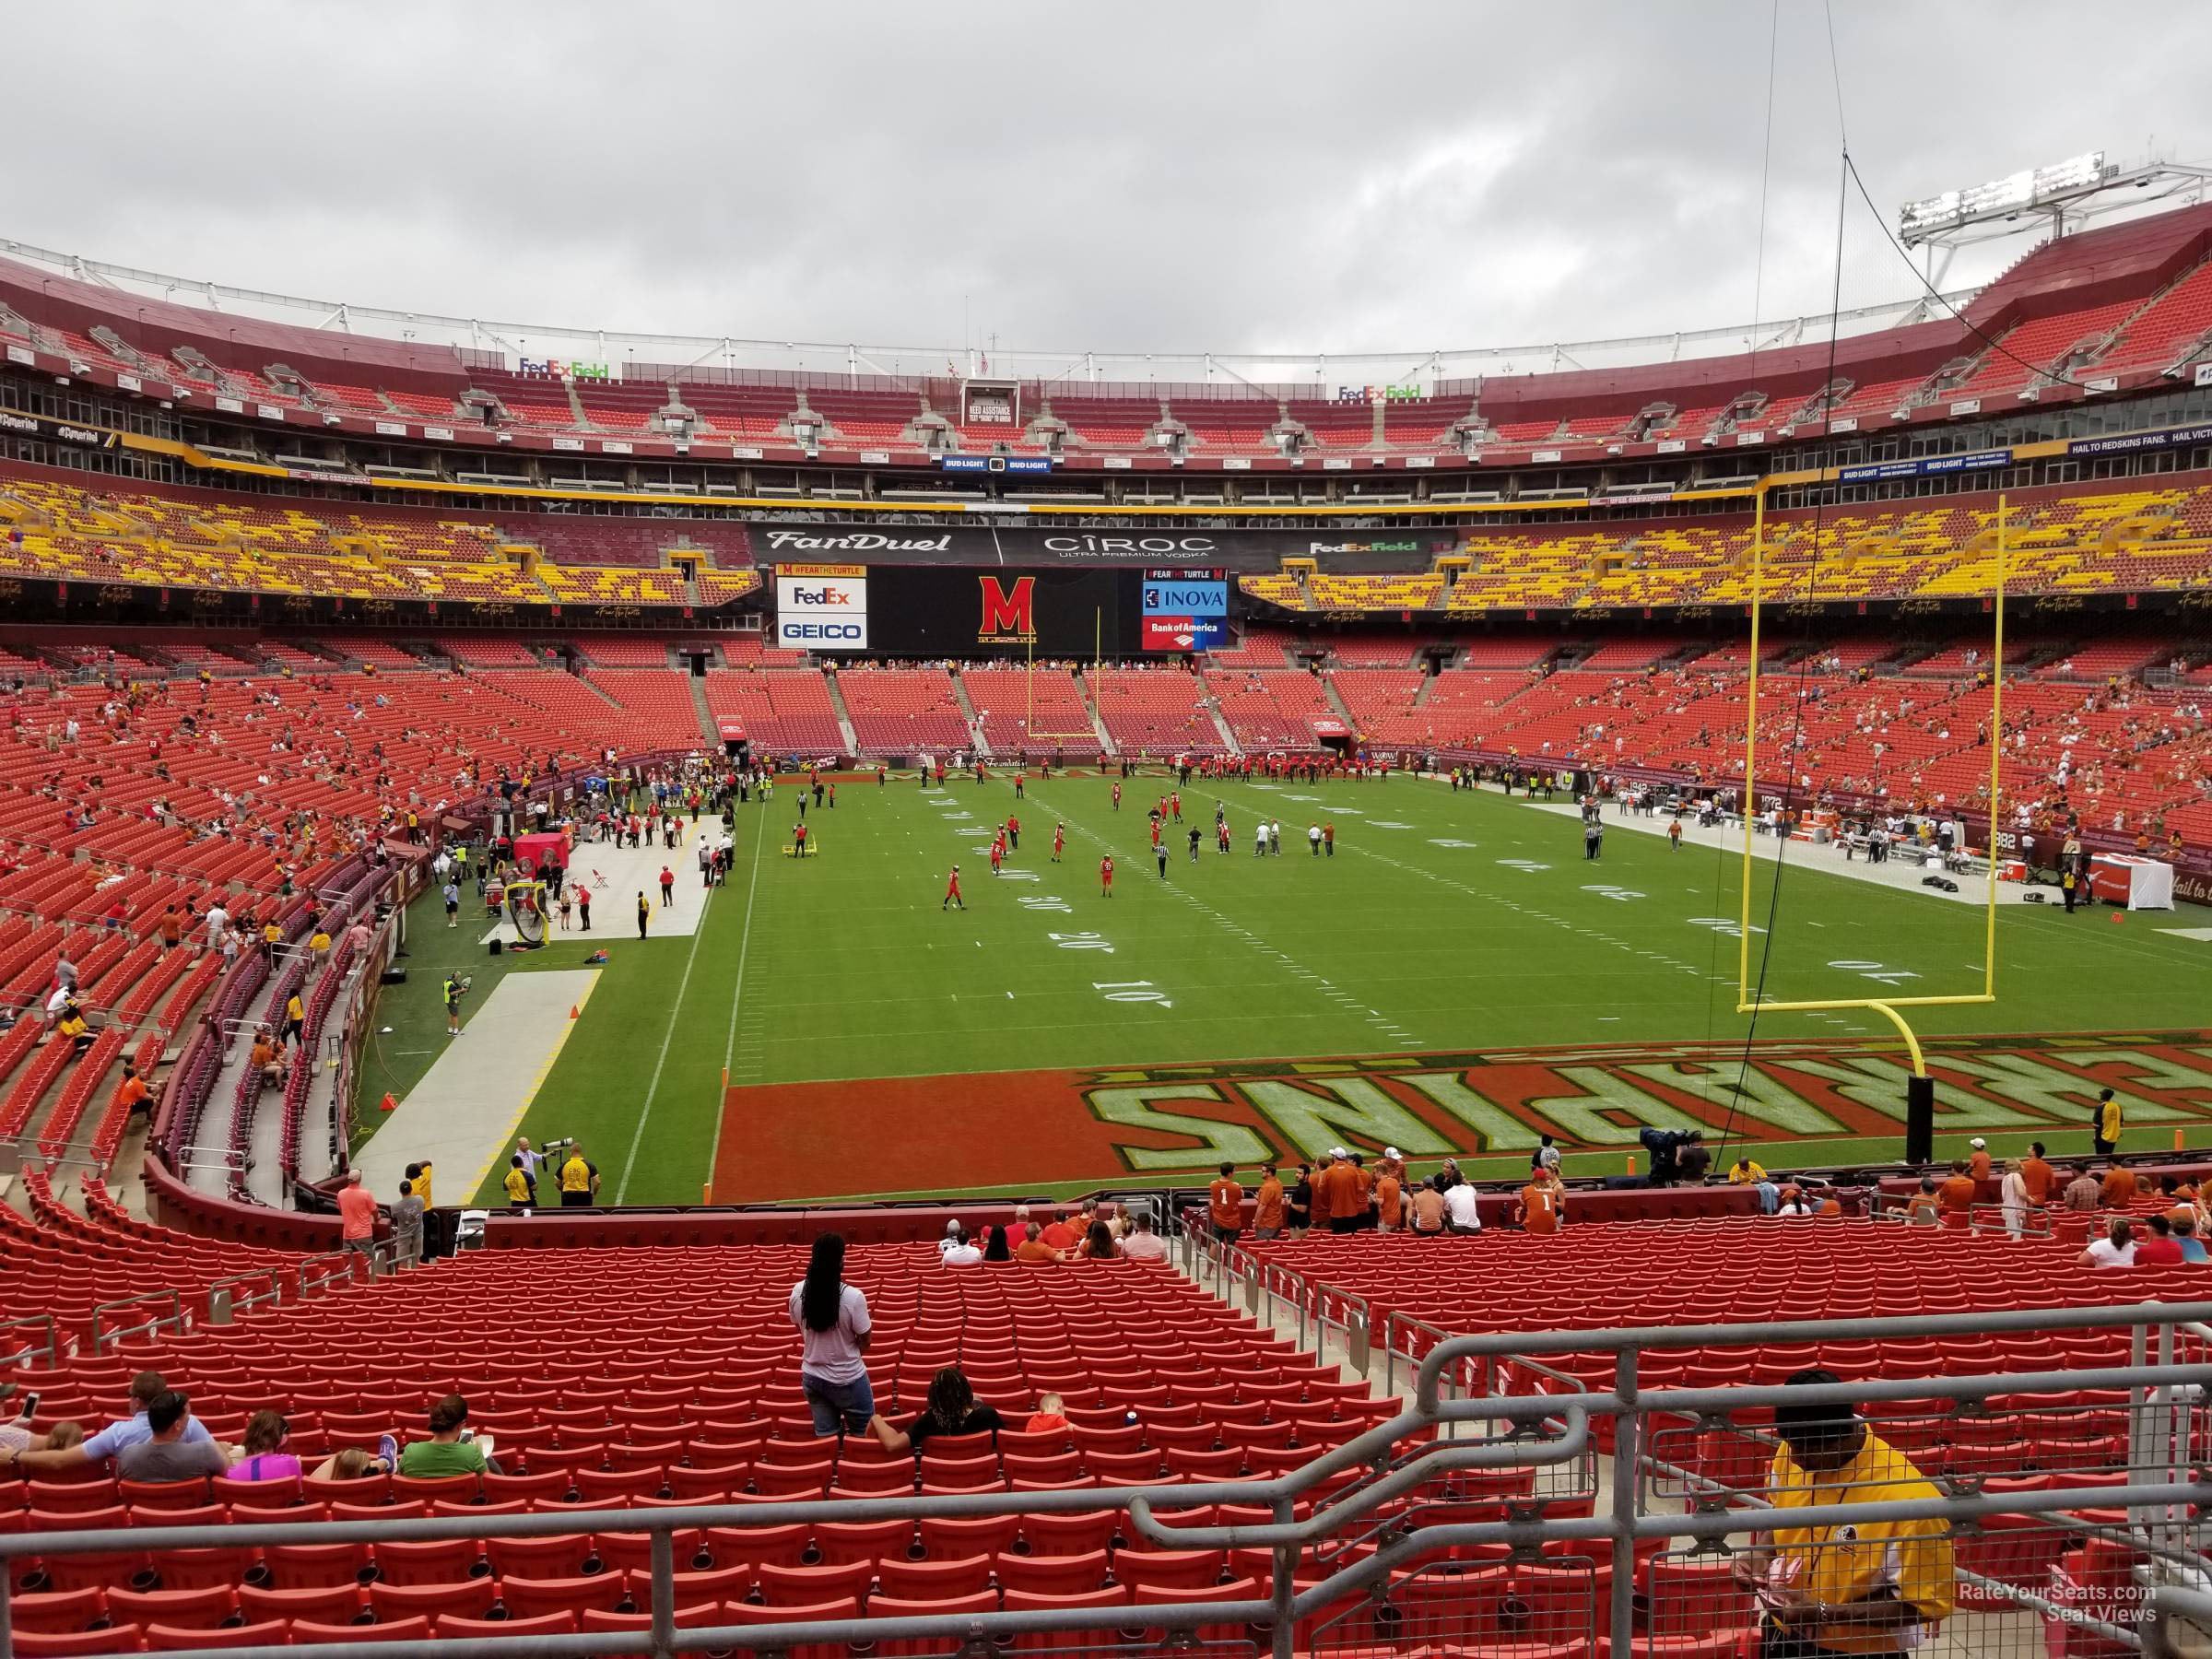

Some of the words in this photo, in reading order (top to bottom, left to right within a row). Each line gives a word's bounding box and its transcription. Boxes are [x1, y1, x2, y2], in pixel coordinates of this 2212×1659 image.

[520, 357, 608, 378] FedExField
[1339, 384, 1420, 400] FedExField
[2073, 444, 2089, 453] HAIL
[2090, 443, 2100, 452] TO
[2102, 438, 2141, 451] REDSKINS
[2143, 435, 2166, 445] FANS.
[2172, 431, 2192, 441] HAIL
[1927, 462, 1942, 470] BUD
[1942, 460, 1963, 468] LIGHT
[1844, 471, 1858, 479] BUD
[1858, 468, 1877, 477] LIGHT
[767, 531, 951, 551] FanDuel
[1311, 542, 1417, 553] FedExField
[795, 566, 860, 575] #FEARTHETURTLE
[794, 587, 850, 605] FedEx
[1166, 591, 1224, 606] INOVA
[978, 576, 1037, 635] M
[783, 624, 862, 639] GEICO
[1152, 623, 1172, 632] Bank
[1173, 623, 1182, 632] of
[1183, 623, 1218, 632] America
[1018, 896, 1069, 910] 30
[1048, 932, 1111, 948] 20
[1827, 960, 1923, 981] 10
[1092, 981, 1165, 1002] 10
[1220, 1188, 1228, 1205] 1
[1543, 1194, 1551, 1211] 1
